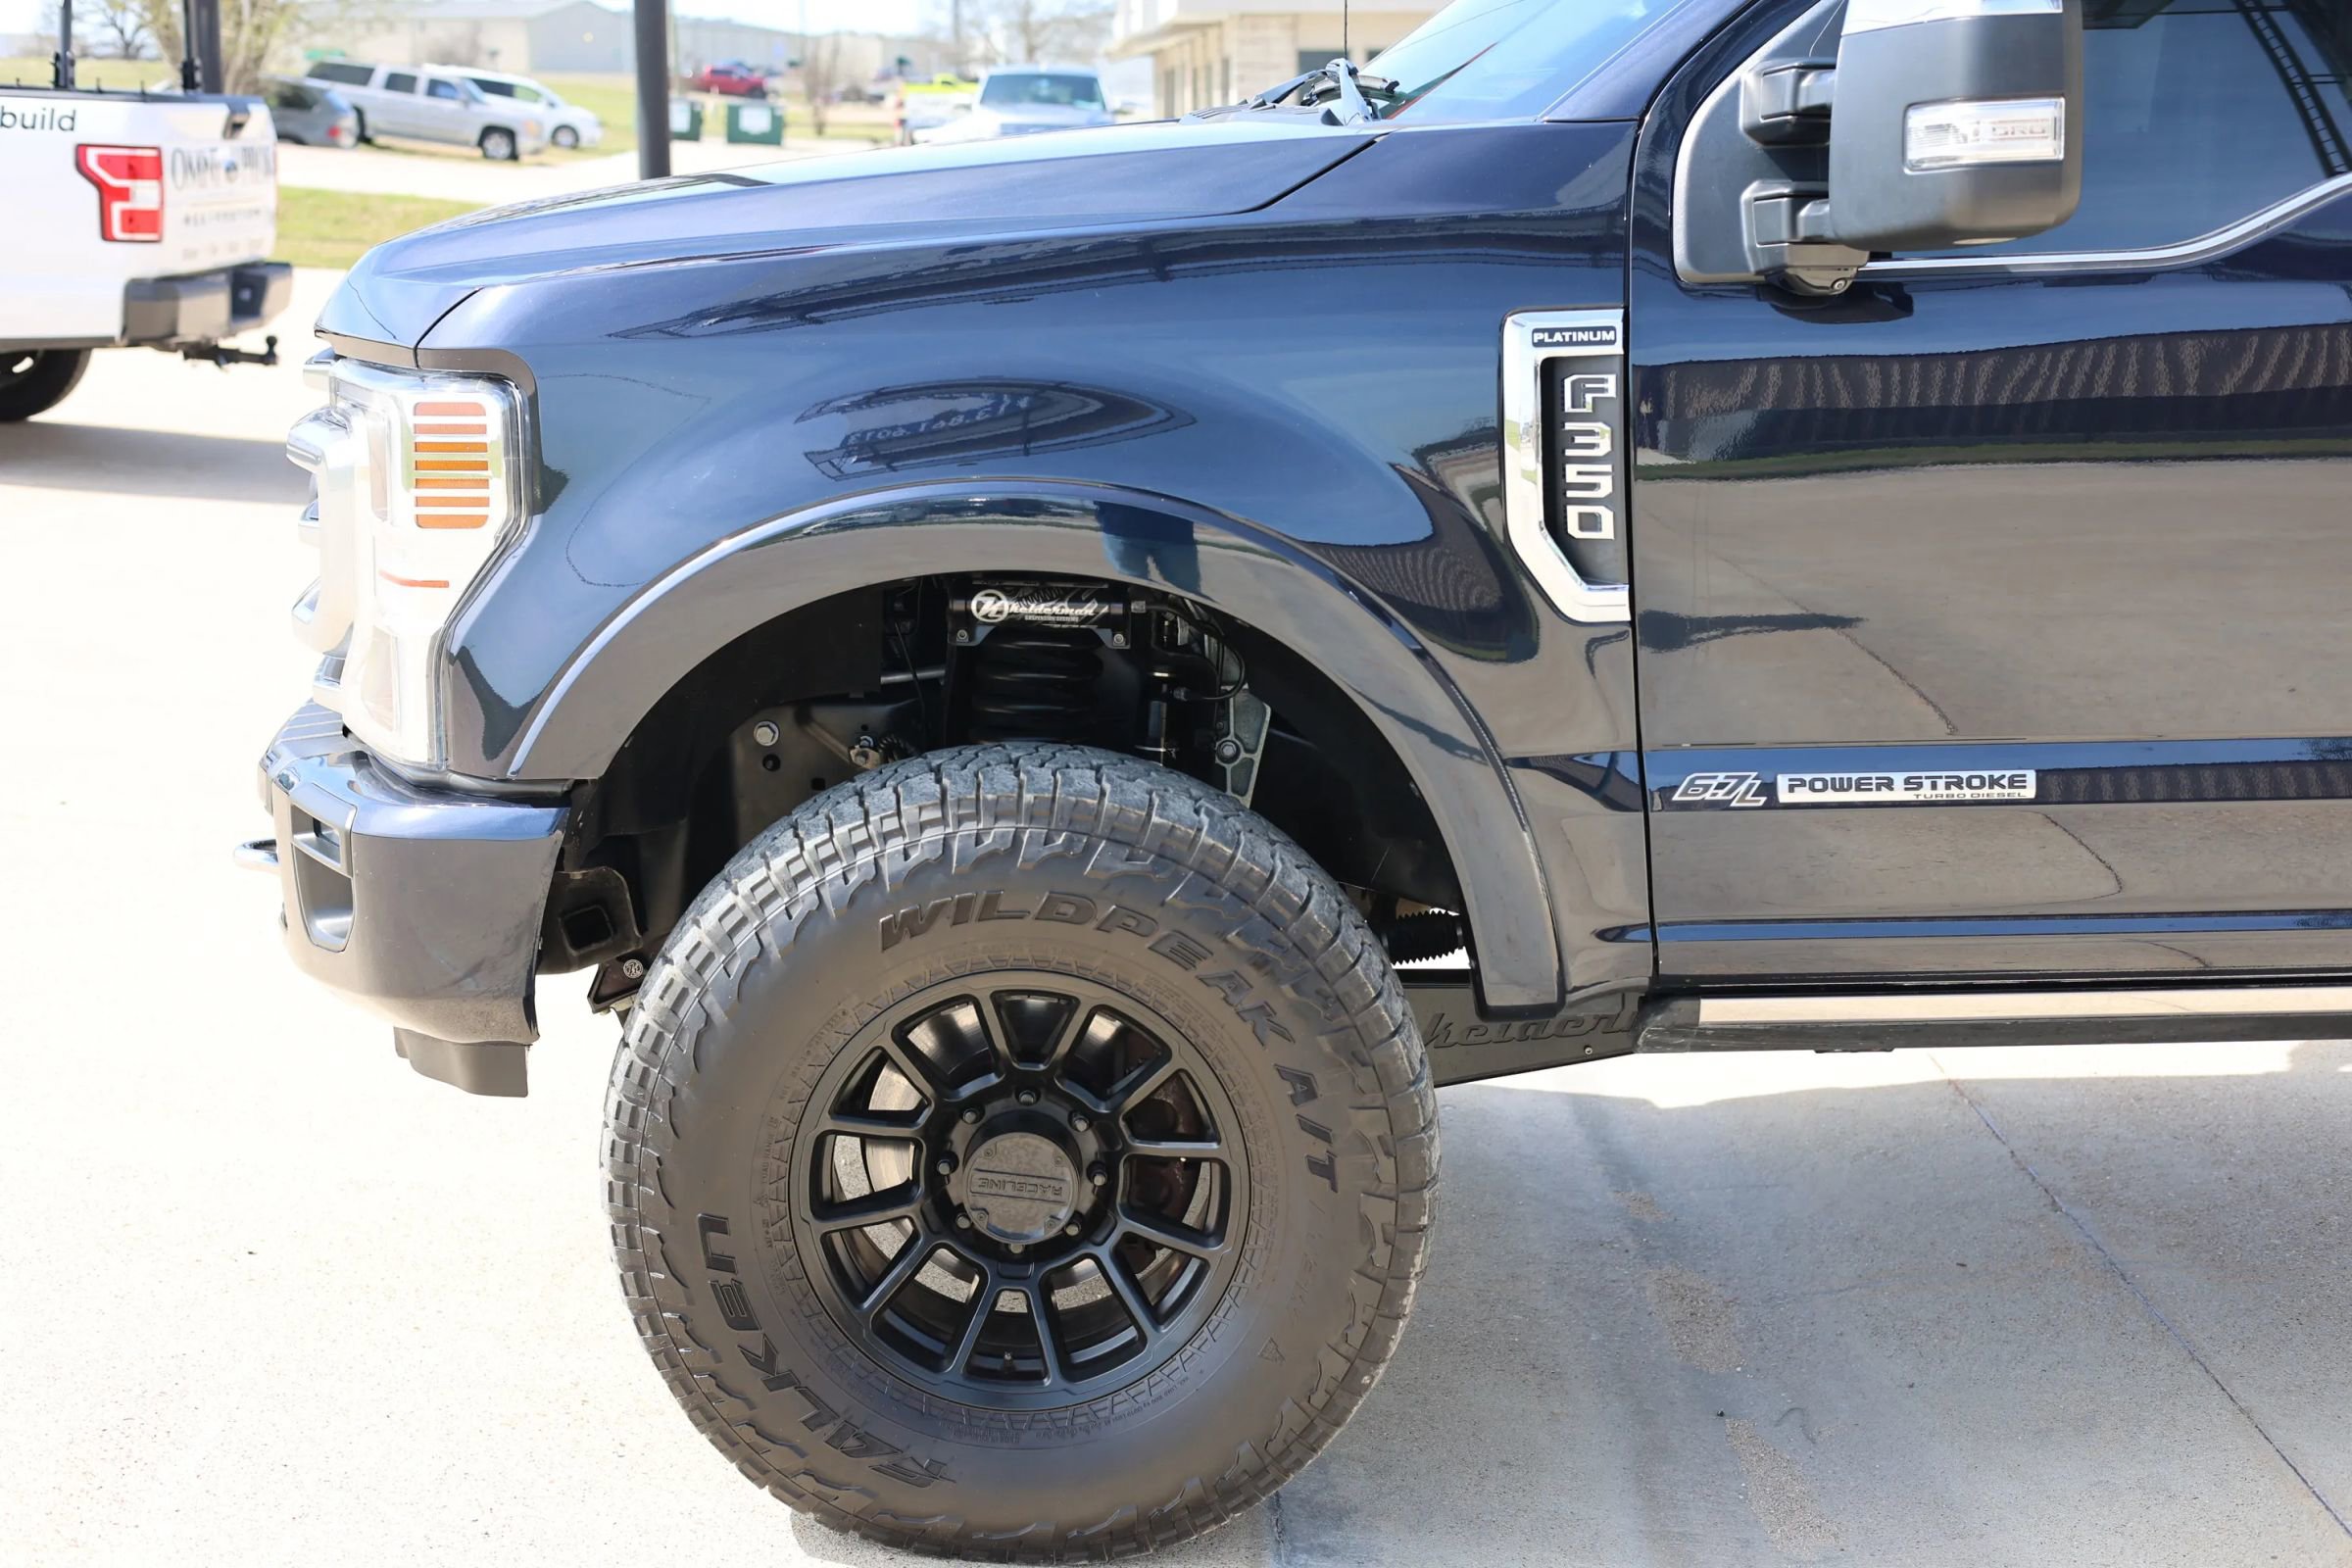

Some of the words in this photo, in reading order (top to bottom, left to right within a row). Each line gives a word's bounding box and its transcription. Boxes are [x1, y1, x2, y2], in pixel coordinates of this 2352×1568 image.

[1533, 329, 1616, 344] PLATINUM
[1672, 771, 1768, 808] 6.7L
[1788, 775, 1894, 794] POWER
[1903, 773, 2028, 792] STROKE
[879, 889, 1296, 1048] WILDPEAK
[978, 1177, 1062, 1197] RACELINE
[697, 1212, 956, 1489] FALKEN
